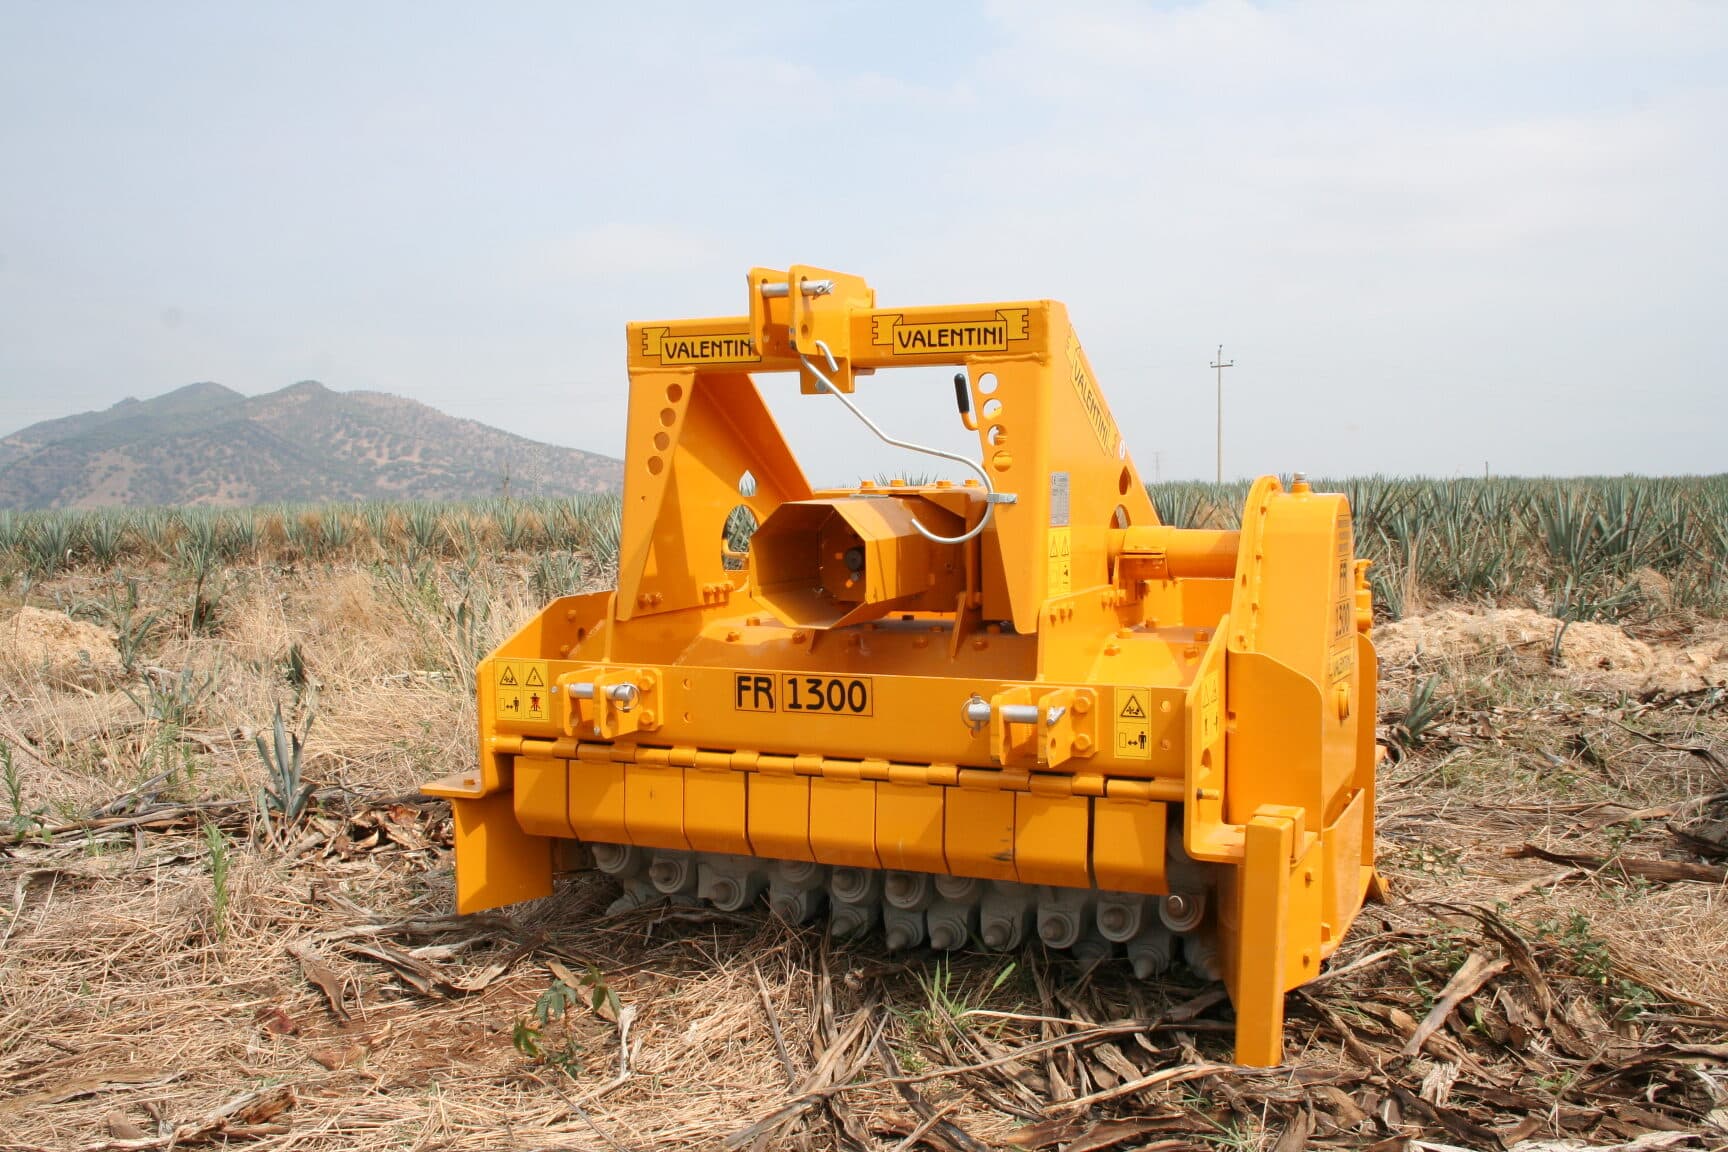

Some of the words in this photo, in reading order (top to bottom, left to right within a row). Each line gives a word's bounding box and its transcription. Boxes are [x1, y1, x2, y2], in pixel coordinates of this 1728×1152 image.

[664, 339, 753, 359] VALENTIN
[897, 326, 1003, 349] VALENTINI
[1072, 359, 1109, 446] VALENTINI
[737, 675, 774, 709] FR
[787, 677, 867, 713] 1300
